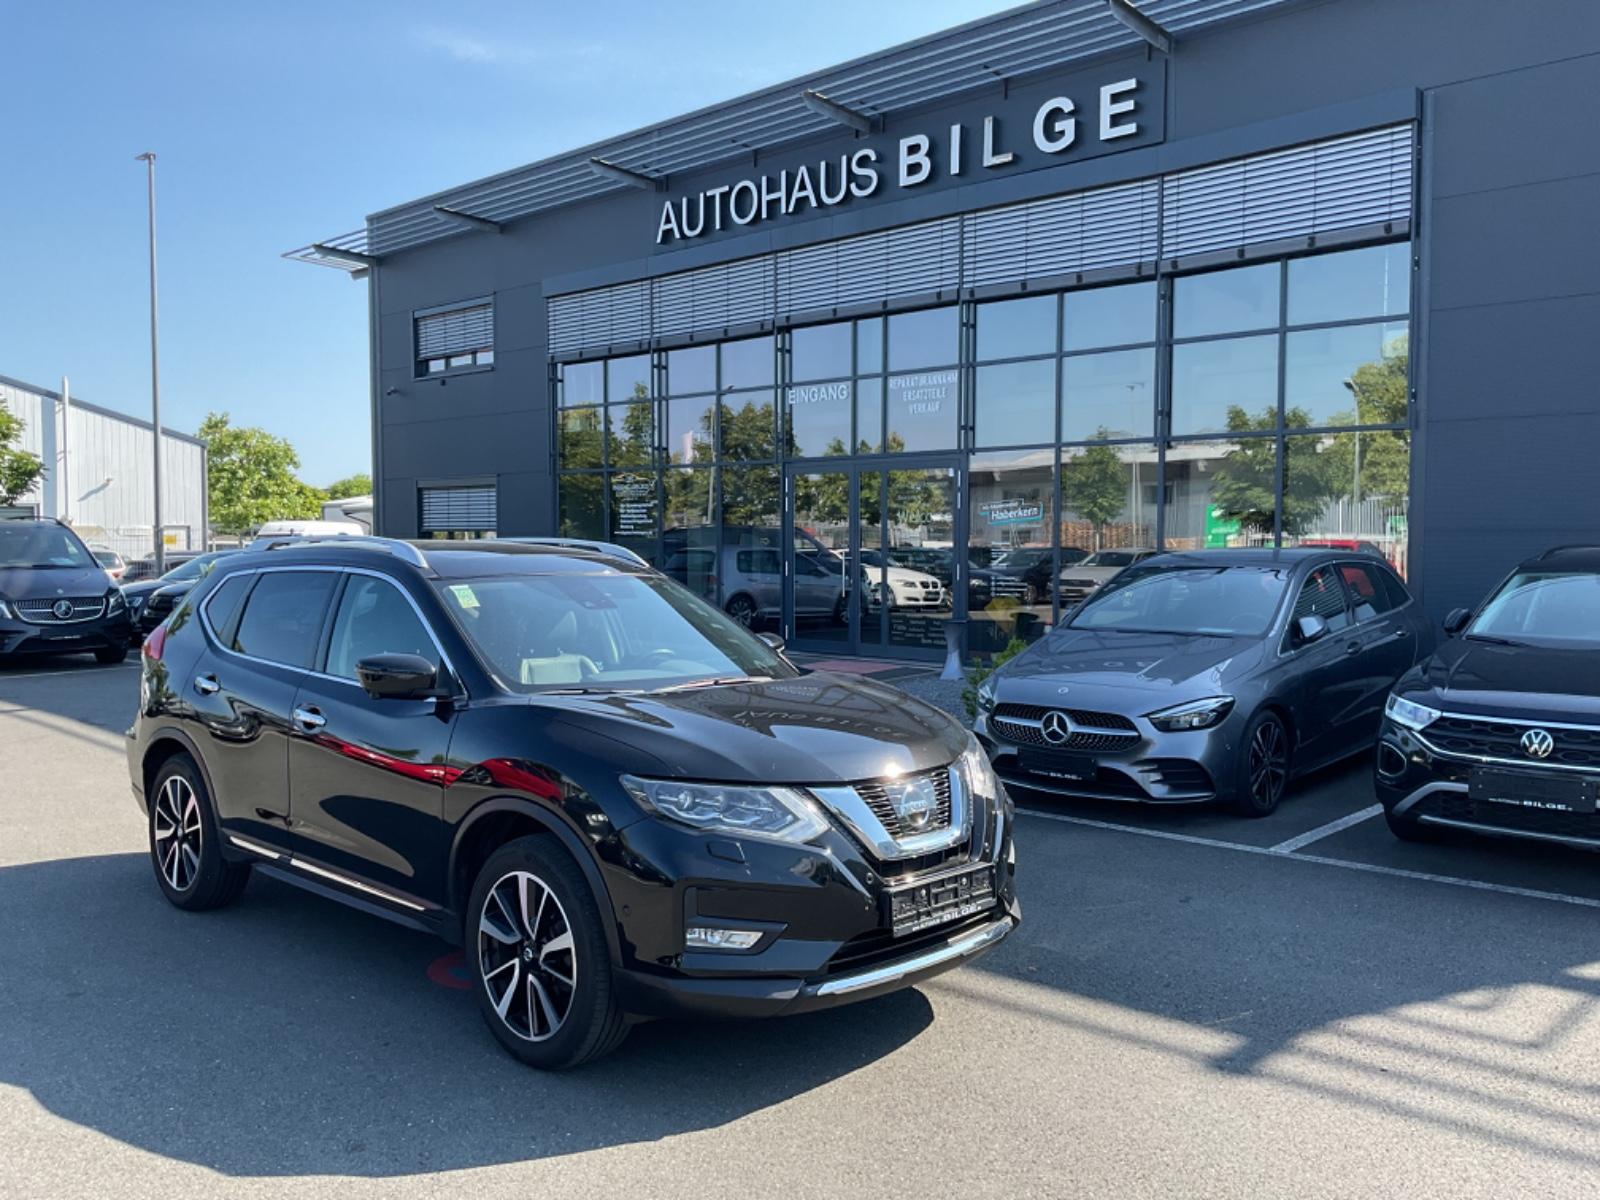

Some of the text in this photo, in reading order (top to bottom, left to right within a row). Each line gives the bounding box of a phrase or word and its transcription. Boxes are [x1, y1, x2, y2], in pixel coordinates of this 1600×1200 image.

[656, 78, 1137, 244] AUTOHAUS BILGE
[788, 384, 848, 405] EINGANG
